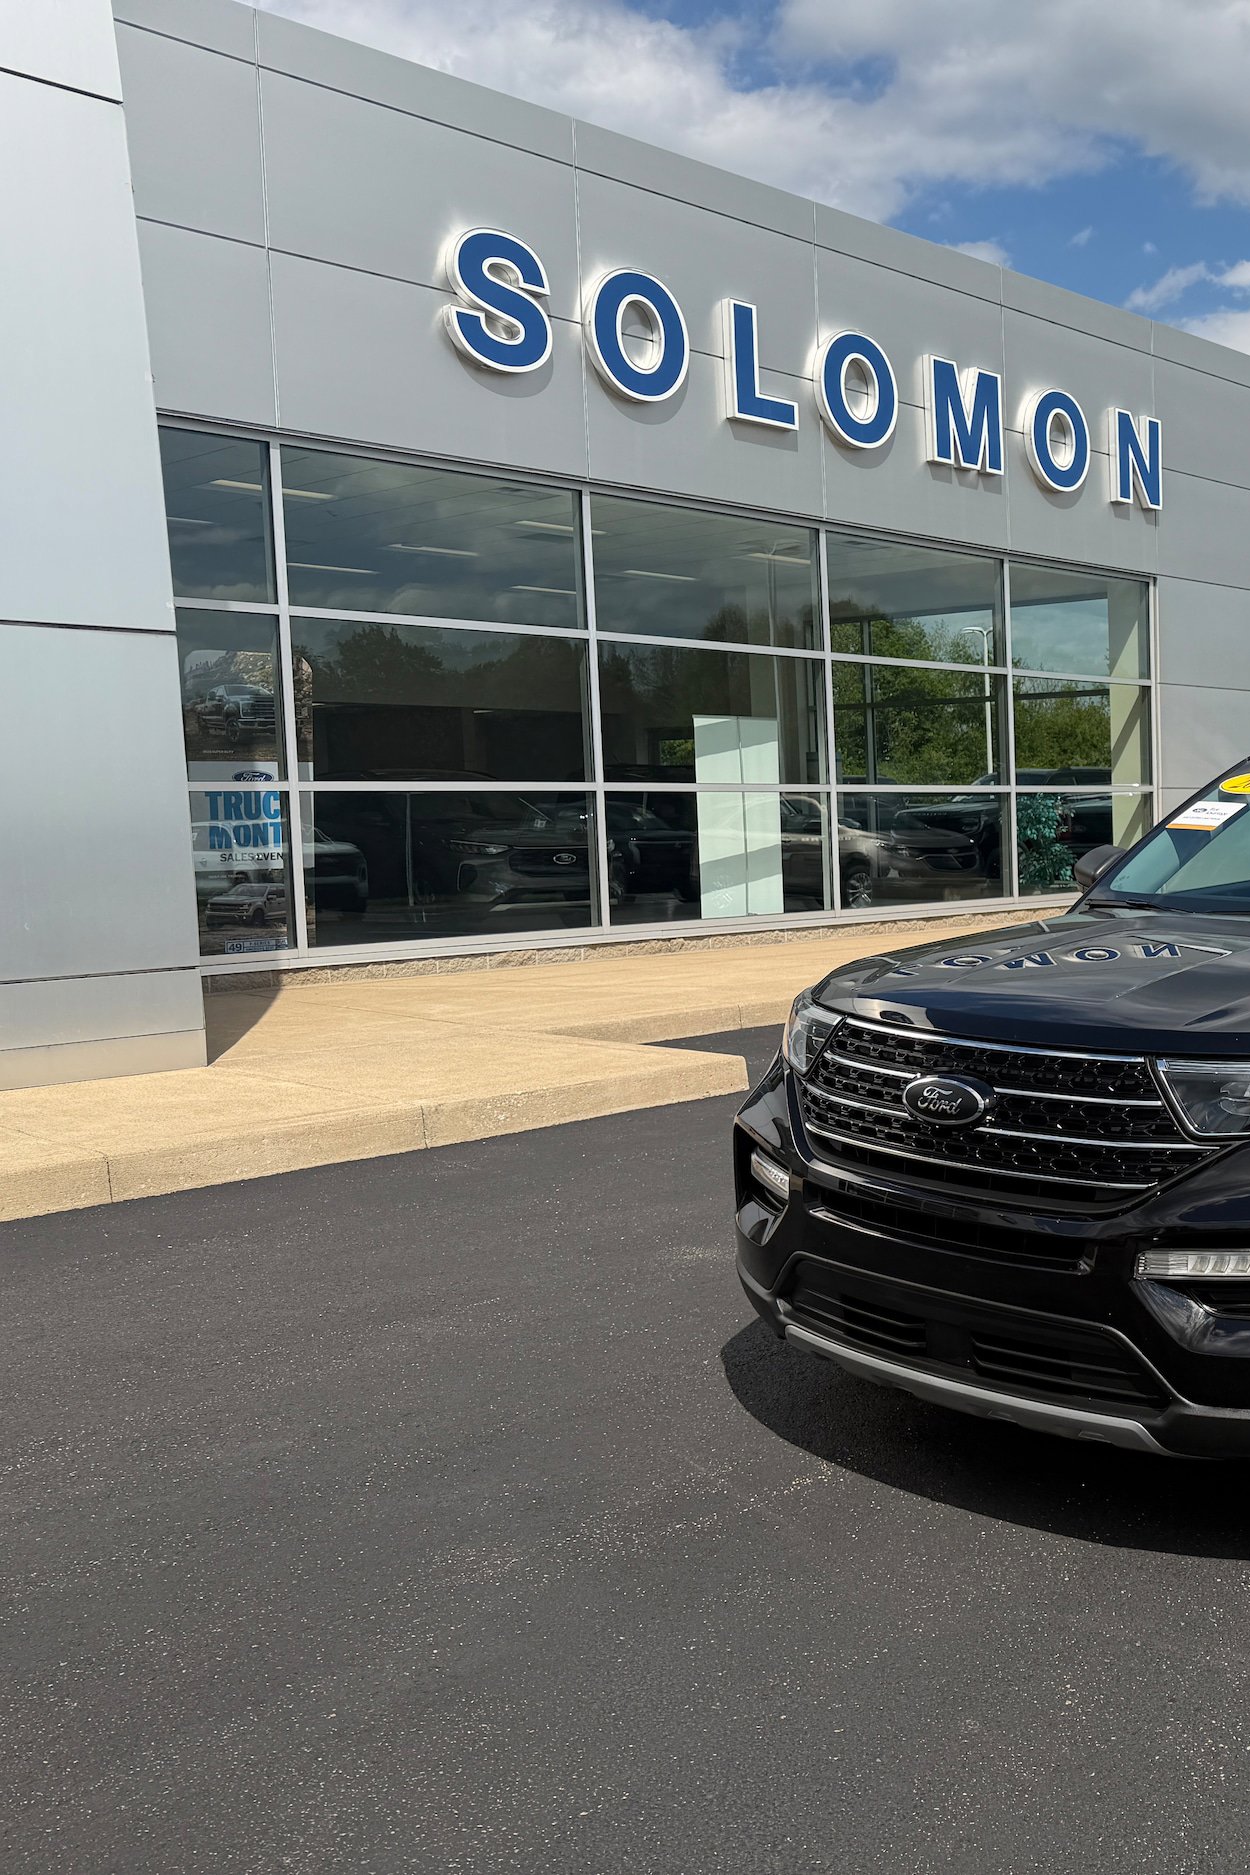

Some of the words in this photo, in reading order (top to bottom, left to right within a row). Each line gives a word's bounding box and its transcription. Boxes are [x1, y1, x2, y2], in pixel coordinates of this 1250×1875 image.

[442, 227, 1163, 510] SOLOMON
[204, 791, 281, 820] TRUC
[209, 821, 282, 849] MONT
[220, 853, 253, 862] SALES
[256, 851, 284, 861] EVEN
[228, 943, 242, 952] 49
[917, 1086, 963, 1116] Ford
